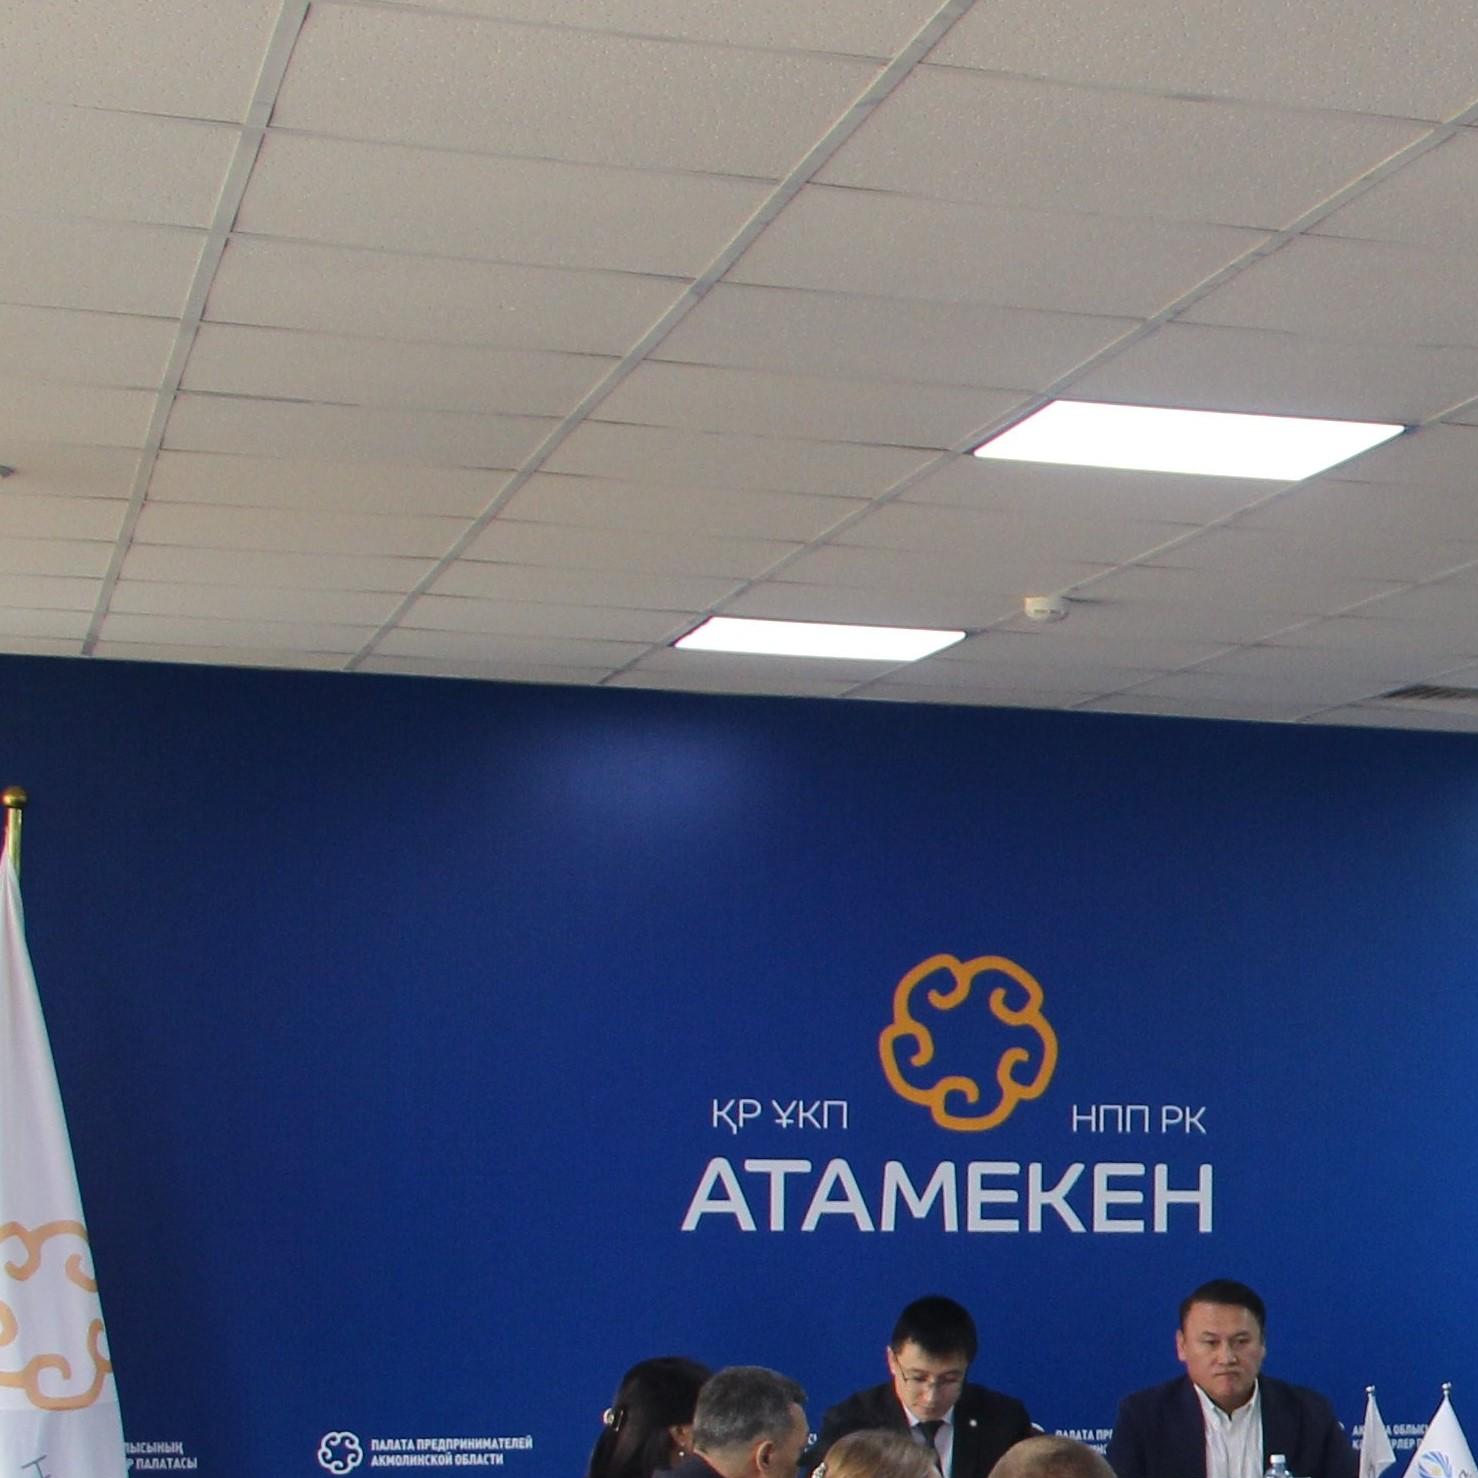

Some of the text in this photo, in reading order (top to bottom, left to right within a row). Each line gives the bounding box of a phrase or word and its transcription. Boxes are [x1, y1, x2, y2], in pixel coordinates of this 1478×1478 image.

[711, 1099, 849, 1135] ҚР ҰКП
[1072, 1104, 1207, 1135] НПП РК
[681, 1156, 1214, 1233] АТАМЕКЕН
[371, 1434, 534, 1452] ПАЛАТА ПРЕДПРИНИМАТЕЛЕЙ
[135, 1457, 198, 1470] ПАЛАТАСЫ
[370, 1452, 504, 1467] АКМОЛИНСКОЙ ОБЛАСТИ
